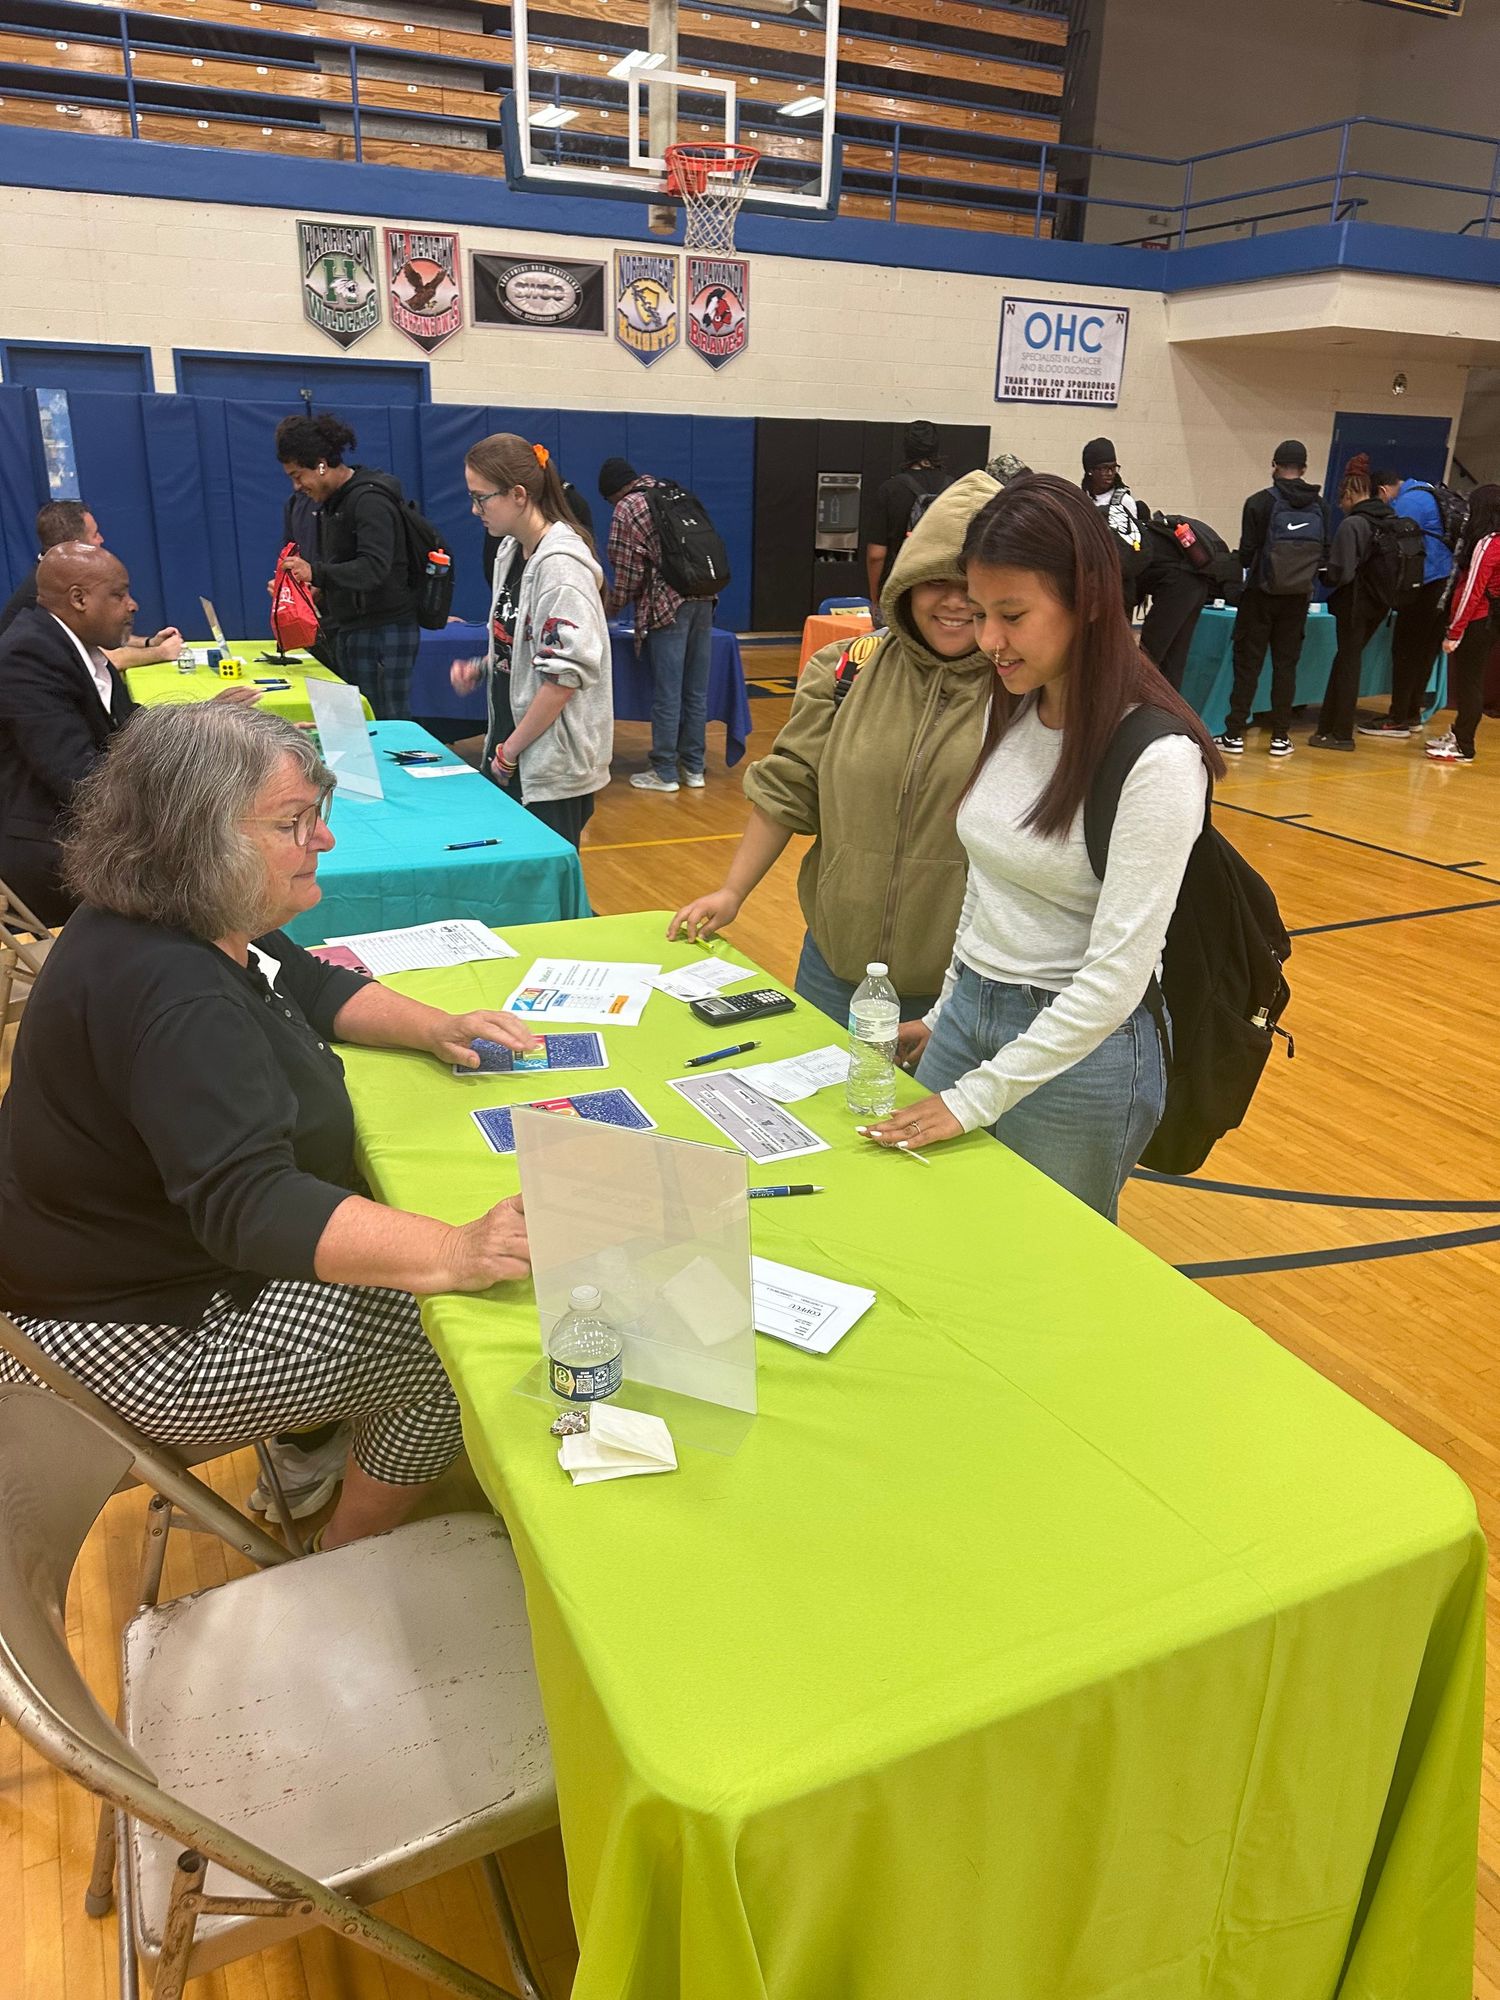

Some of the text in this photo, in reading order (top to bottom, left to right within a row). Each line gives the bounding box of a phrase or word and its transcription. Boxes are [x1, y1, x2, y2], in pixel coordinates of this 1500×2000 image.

[301, 224, 374, 280] HARRISON
[619, 256, 675, 302] NORTHWEST
[308, 291, 376, 333] WILDCATS
[689, 317, 745, 356] BRAVES
[1024, 311, 1105, 353] OHC
[1019, 364, 1102, 376] AND BLOOD DISORDERS
[1021, 352, 1102, 365] SPECIALISTS IN CANCER
[1004, 386, 1115, 401] NORTHWEST ATHLETICS
[1005, 376, 1116, 390] THANK YOU FOR SPONSORING
